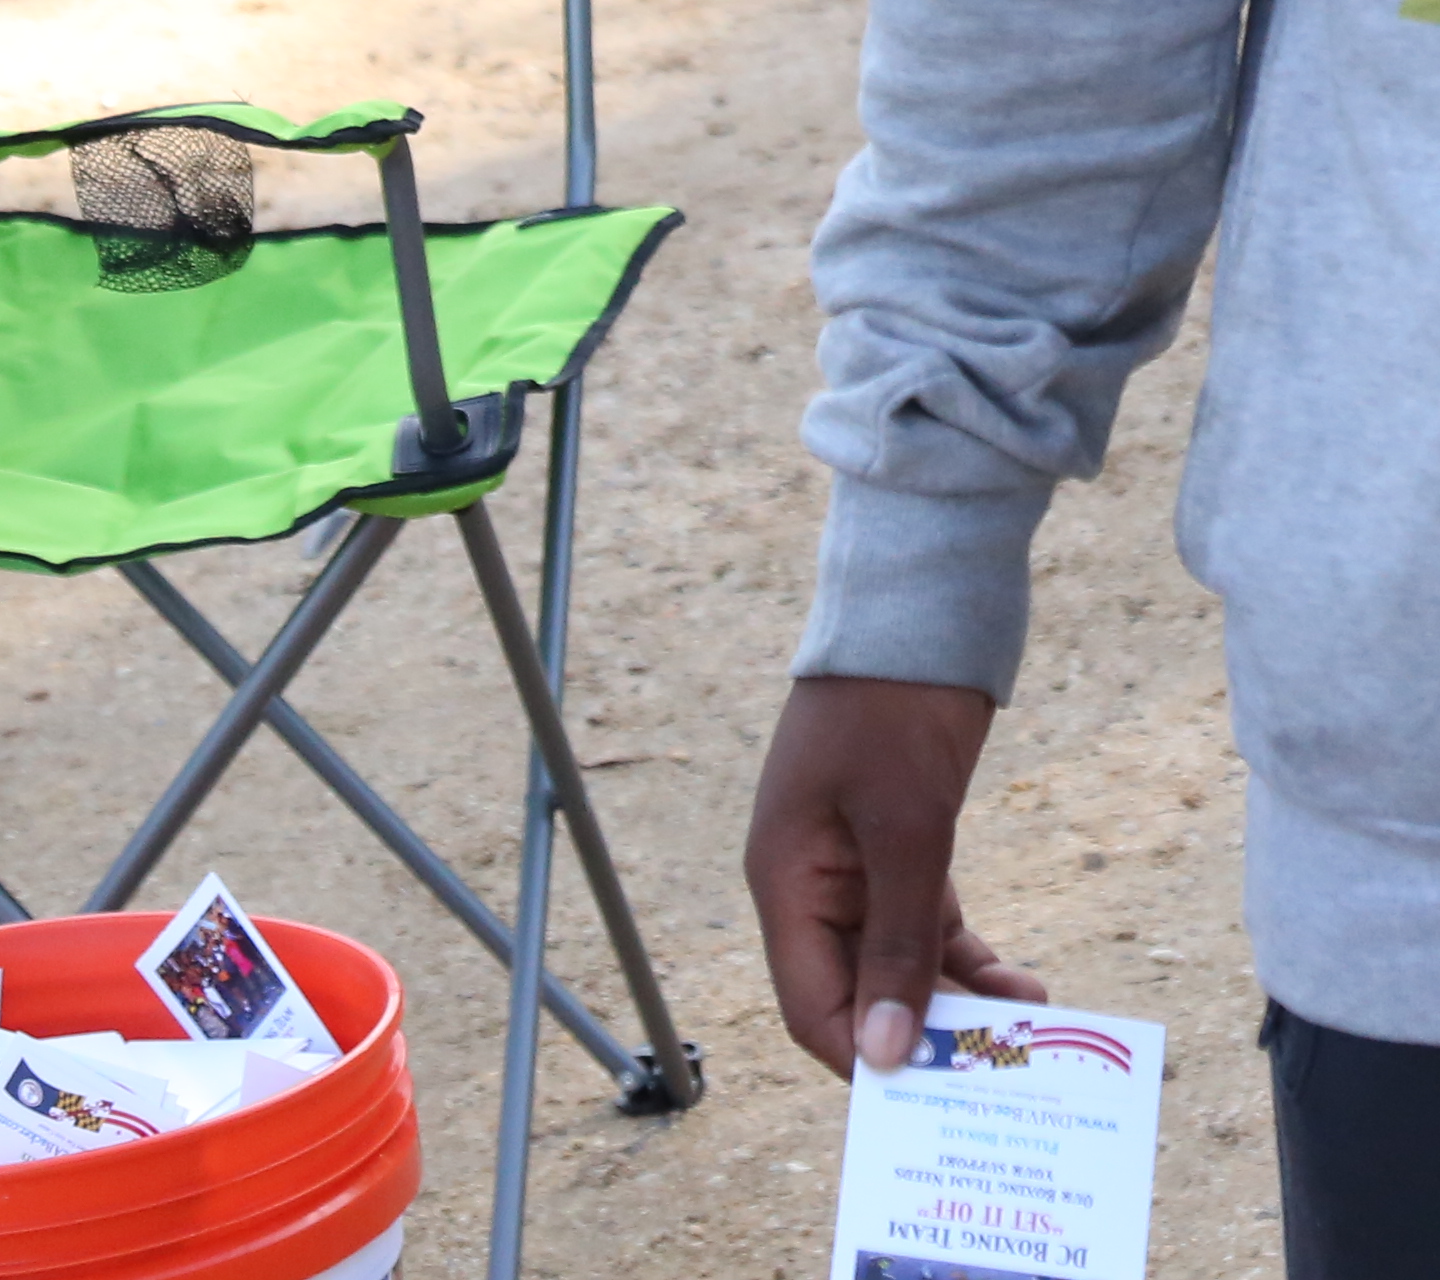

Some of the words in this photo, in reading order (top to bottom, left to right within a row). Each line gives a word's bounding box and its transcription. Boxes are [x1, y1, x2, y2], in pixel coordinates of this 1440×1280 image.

[937, 1154, 1006, 1175] SUPPORT
[980, 1205, 1004, 1228] IT
[888, 1220, 953, 1250] TEAM
[960, 1230, 1049, 1263] BOXING
[1056, 1244, 1089, 1269] DC
